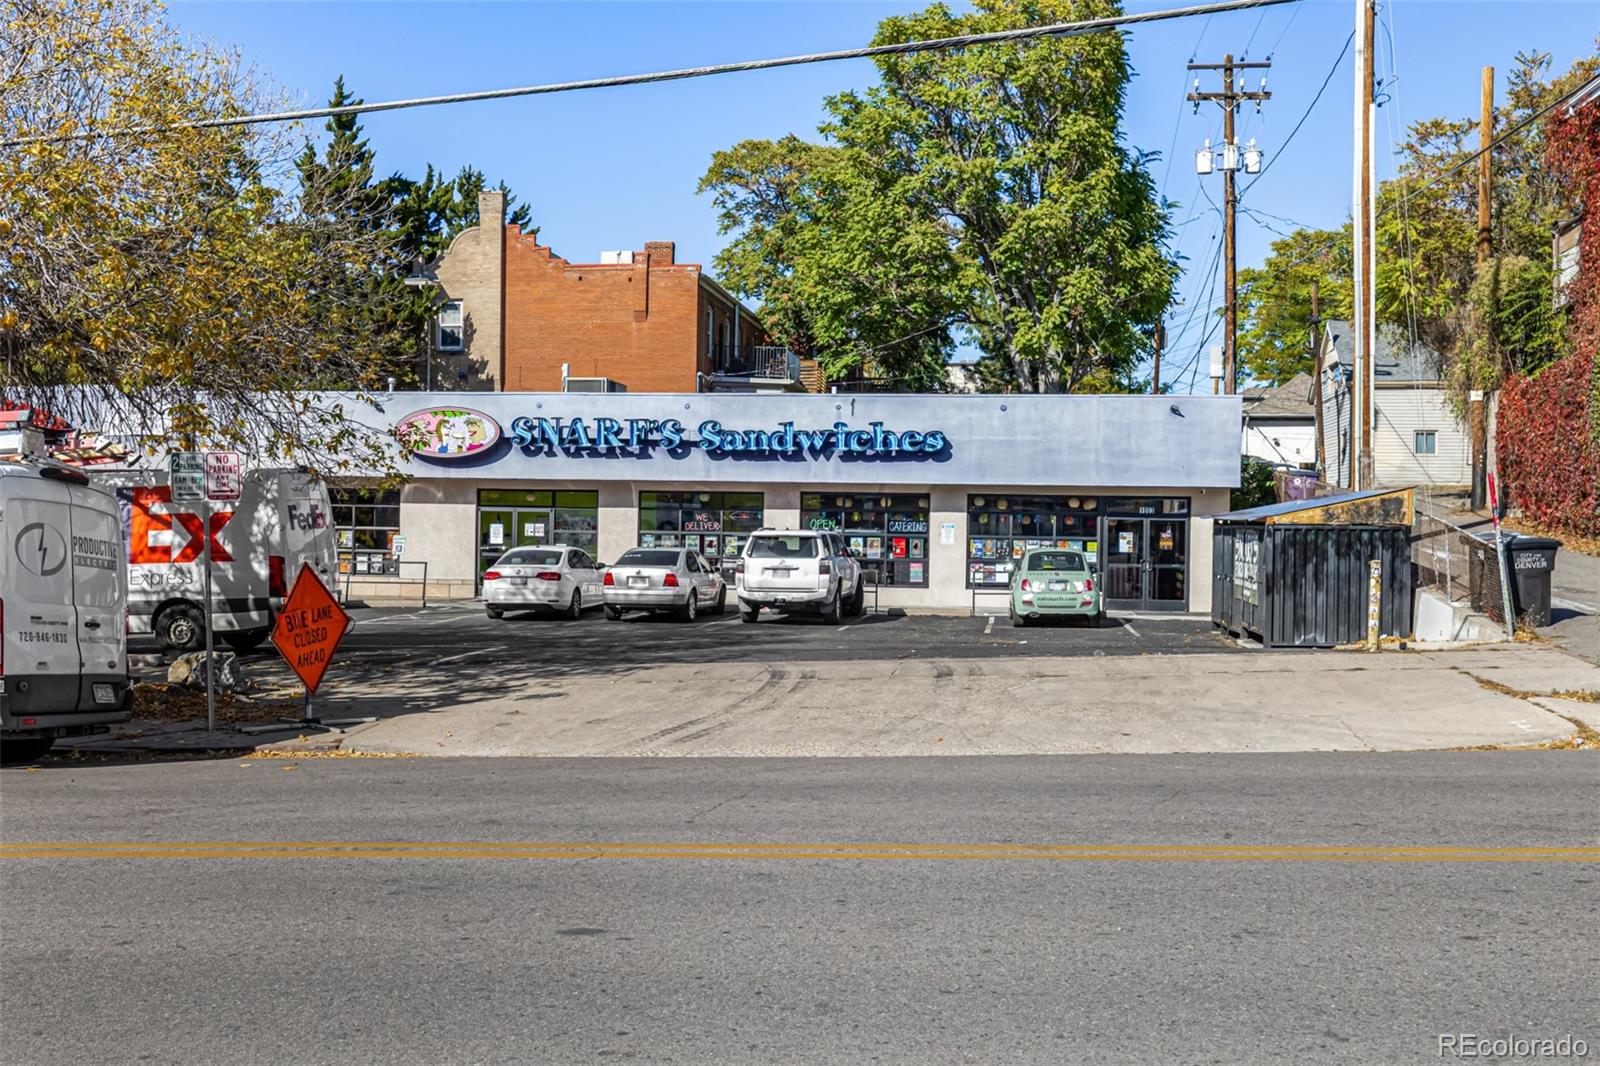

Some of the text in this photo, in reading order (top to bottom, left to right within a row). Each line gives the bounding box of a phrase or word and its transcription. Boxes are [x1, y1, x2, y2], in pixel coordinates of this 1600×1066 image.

[511, 416, 946, 452] SNARF'S Sandwiches
[172, 456, 179, 470] 2
[215, 455, 229, 464] NO
[208, 465, 238, 474] PARKING
[288, 505, 329, 531] FedEx
[695, 513, 709, 521] WE
[809, 519, 836, 529] OPEN
[684, 521, 720, 531] DELIVER
[889, 521, 927, 532] CATERING
[73, 536, 118, 559] PRODUCTIVE
[1515, 561, 1547, 569] DENVER
[130, 569, 194, 589] Express
[310, 605, 333, 623] LANE
[294, 627, 328, 648] CLOSED
[296, 649, 326, 668] AHEAD
